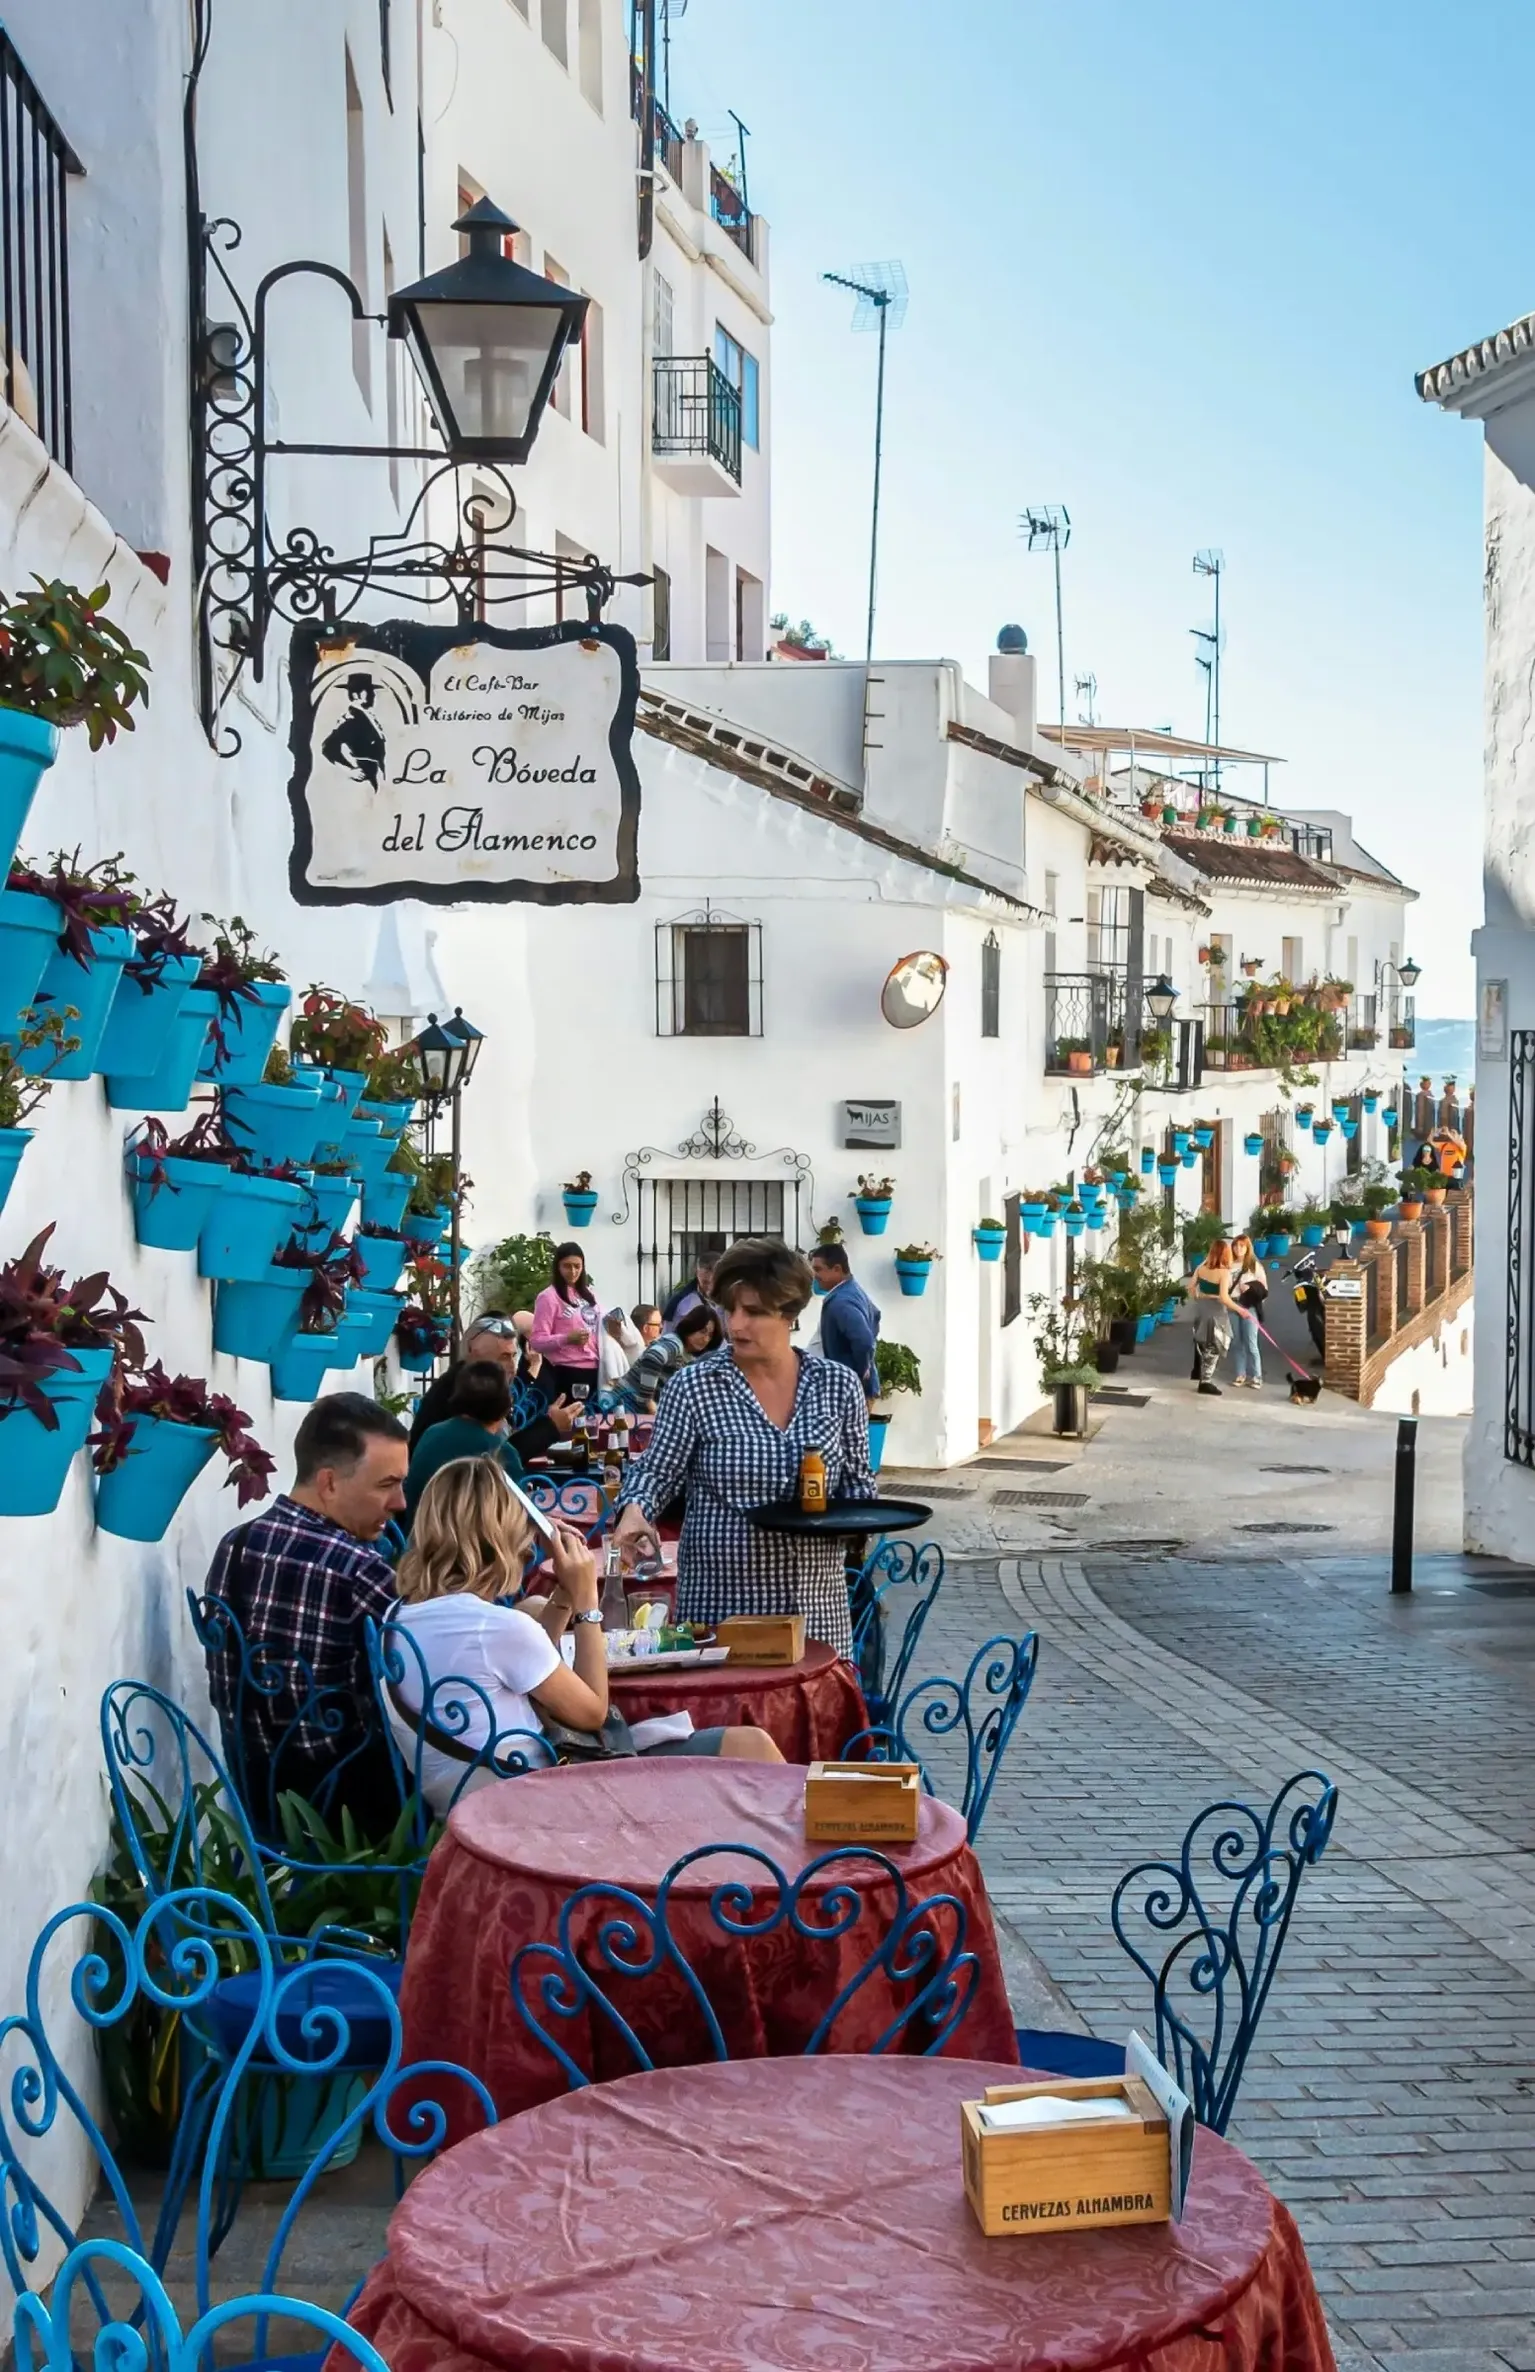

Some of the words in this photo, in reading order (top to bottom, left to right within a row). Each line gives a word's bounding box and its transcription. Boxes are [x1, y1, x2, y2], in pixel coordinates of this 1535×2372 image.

[444, 675, 461, 692] El
[465, 674, 540, 694] Café-Bar
[423, 705, 492, 721] Histórico
[497, 707, 513, 721] de
[517, 704, 565, 726] Mijas
[392, 748, 447, 784] La
[471, 745, 597, 784] Bóveda
[381, 812, 426, 852] del
[435, 806, 597, 852] Flamenco
[846, 1106, 890, 1127] MIJAS
[1002, 2201, 1071, 2222] CERVEZAS
[1076, 2192, 1155, 2215] ALHAMBRA
